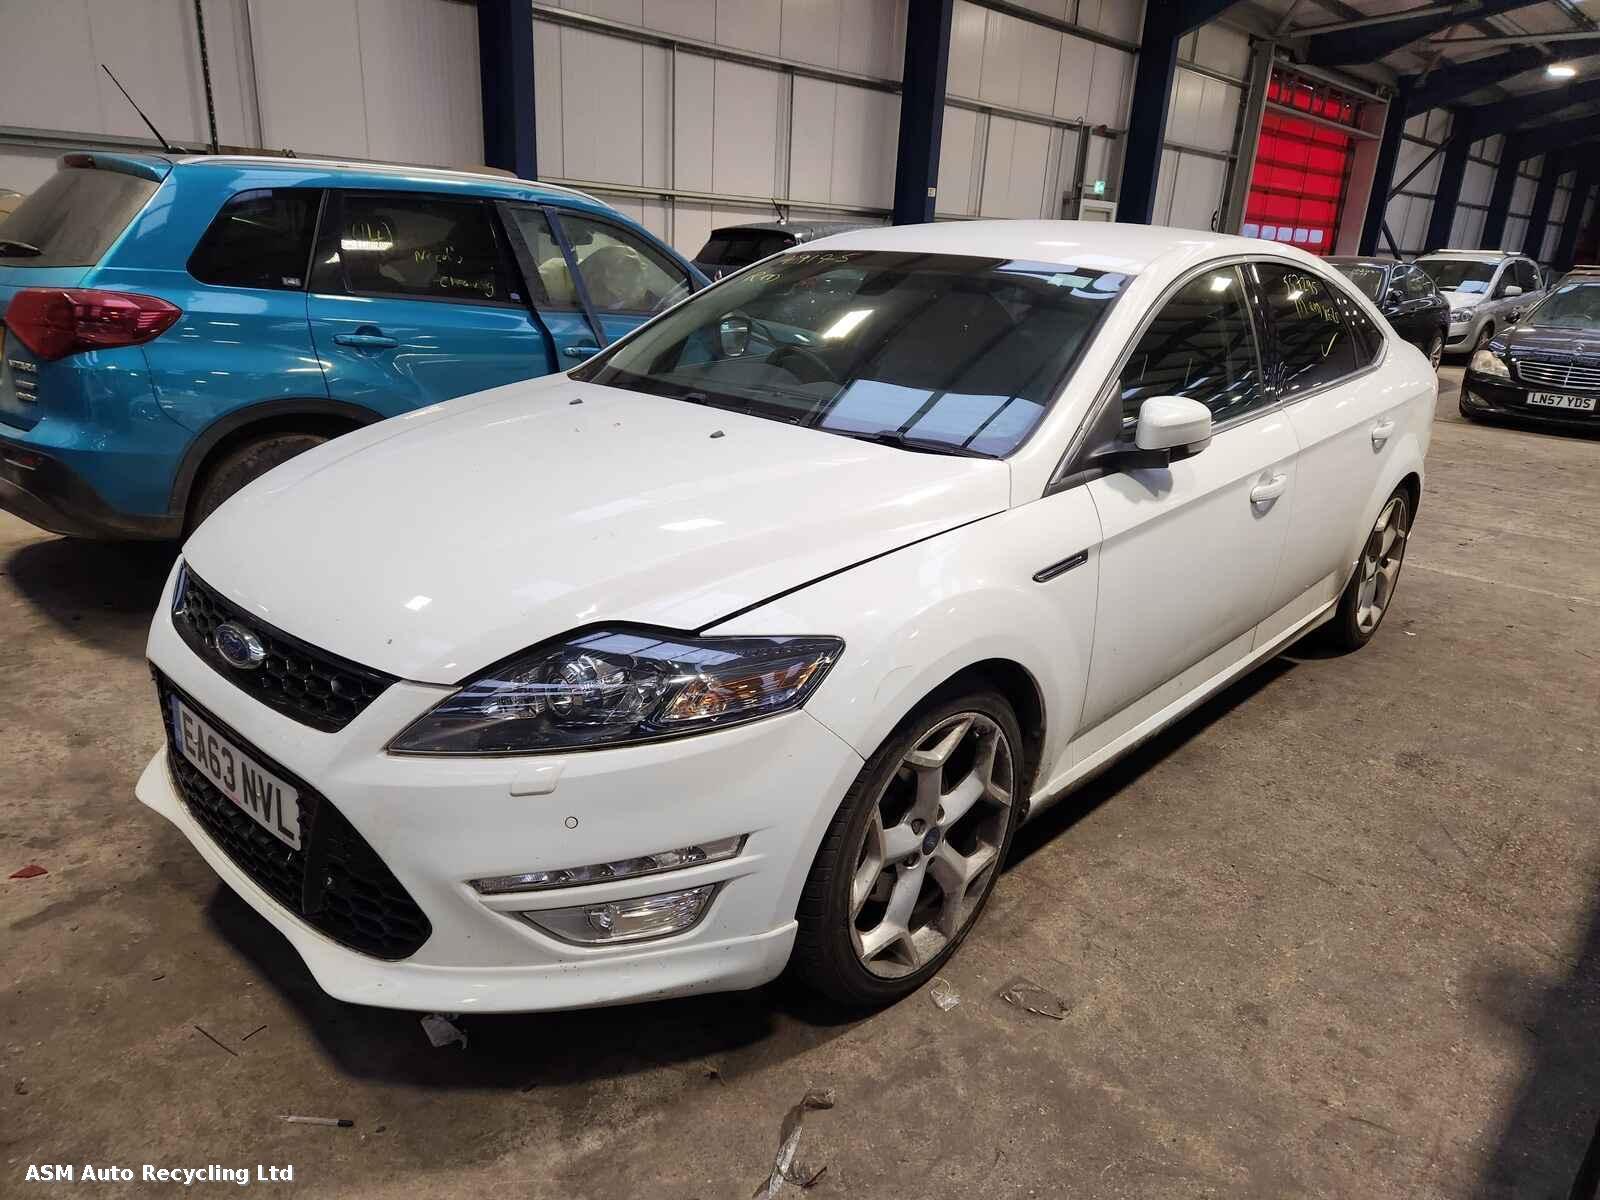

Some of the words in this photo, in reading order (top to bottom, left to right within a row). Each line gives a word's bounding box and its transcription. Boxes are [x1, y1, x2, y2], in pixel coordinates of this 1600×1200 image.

[1531, 392, 1564, 406] LN57
[1567, 396, 1592, 409] YDS
[182, 710, 236, 793] EA63
[241, 760, 295, 841] NVL
